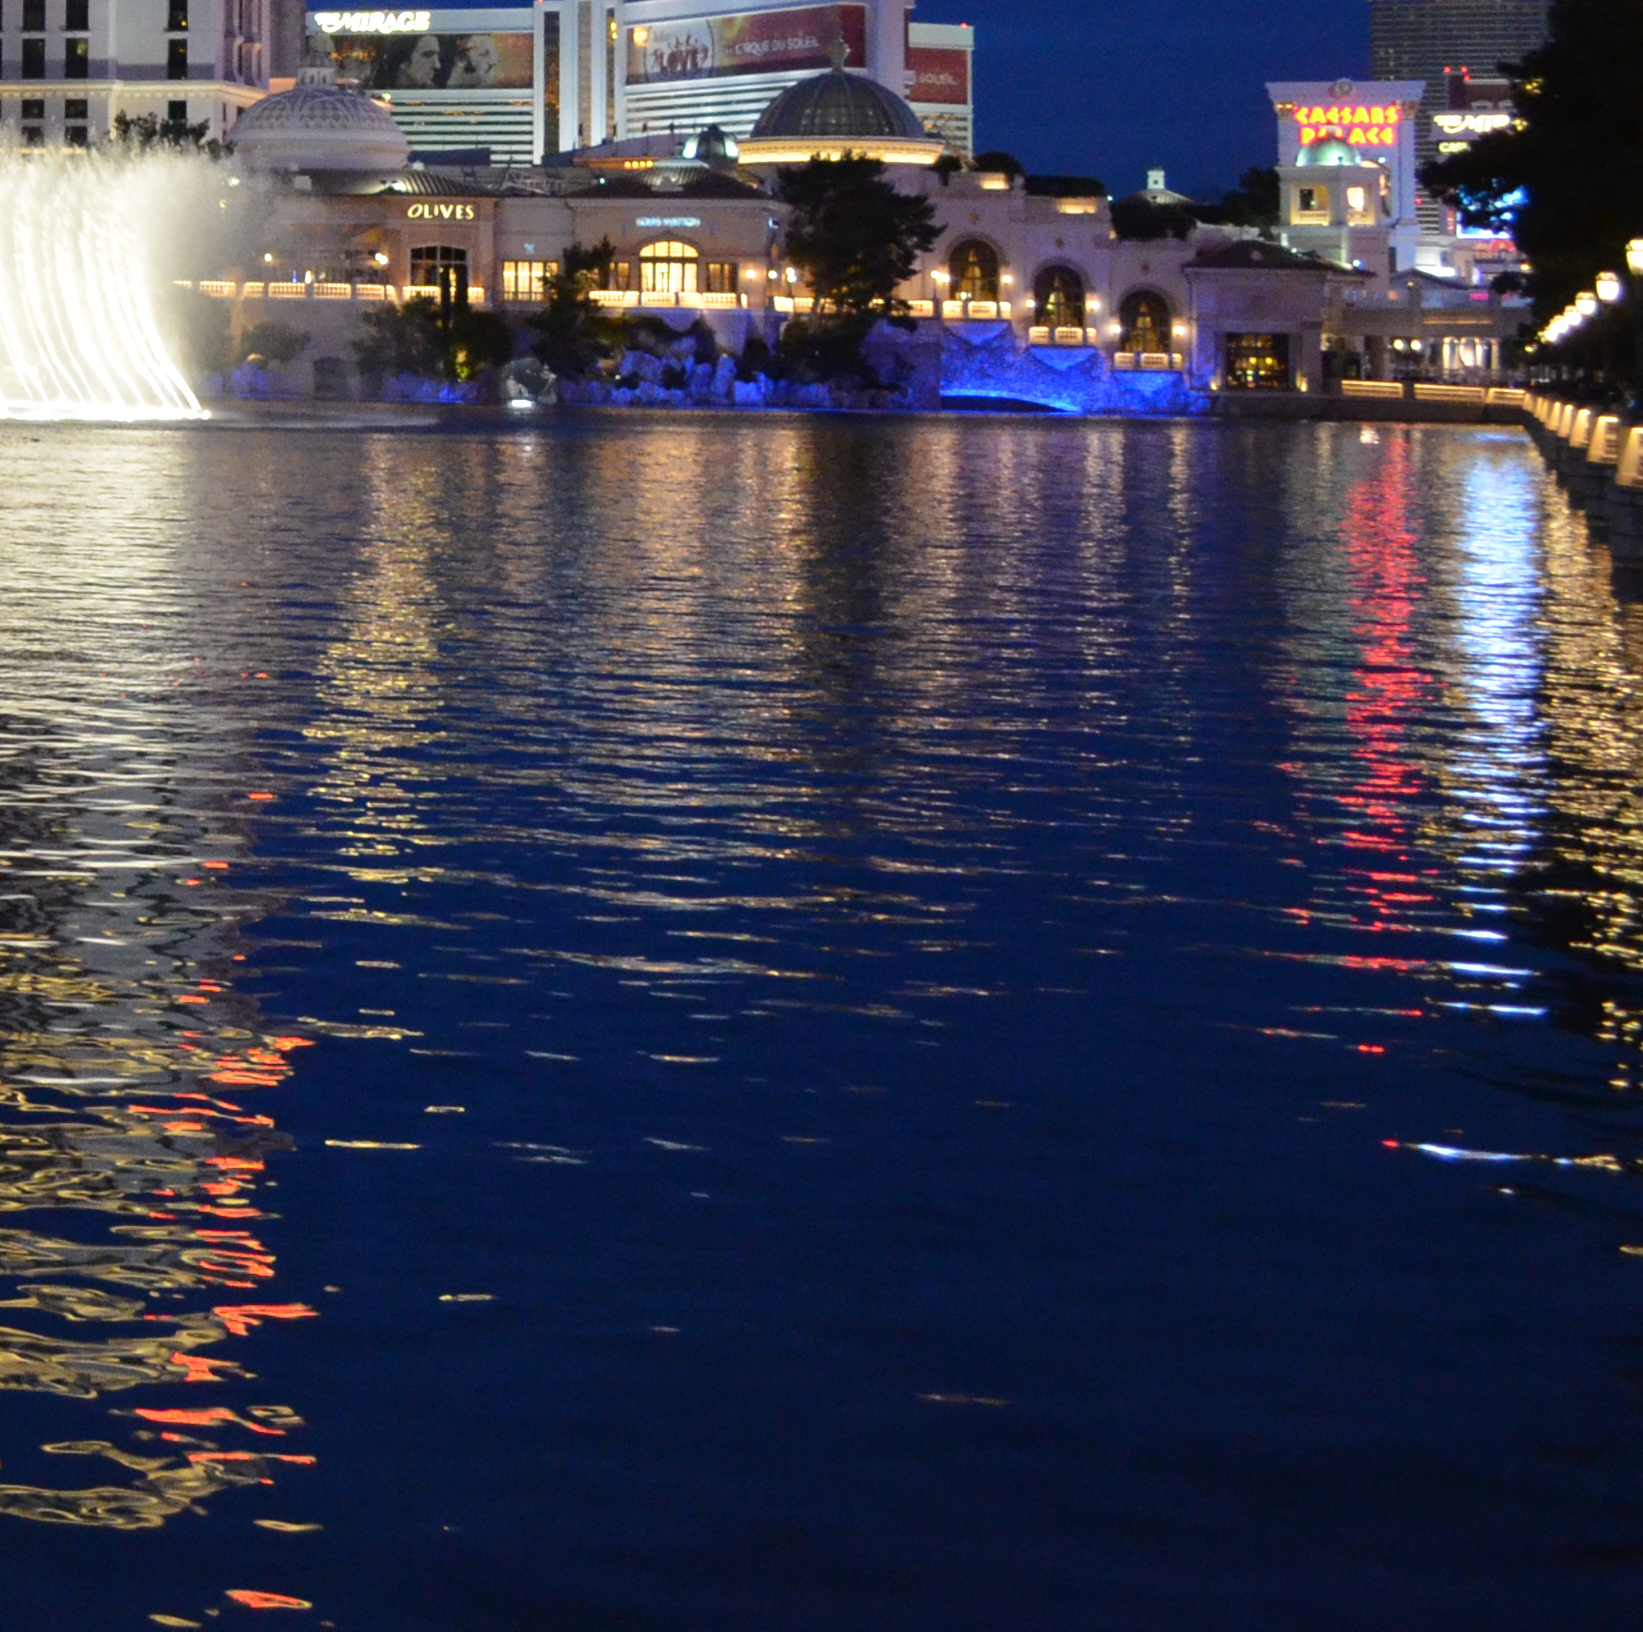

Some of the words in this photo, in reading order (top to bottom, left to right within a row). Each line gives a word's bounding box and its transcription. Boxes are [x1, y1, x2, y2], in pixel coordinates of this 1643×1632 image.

[322, 11, 432, 35] MIRAGE
[1294, 105, 1400, 125] CAESARS
[407, 203, 475, 220] OLIVES
